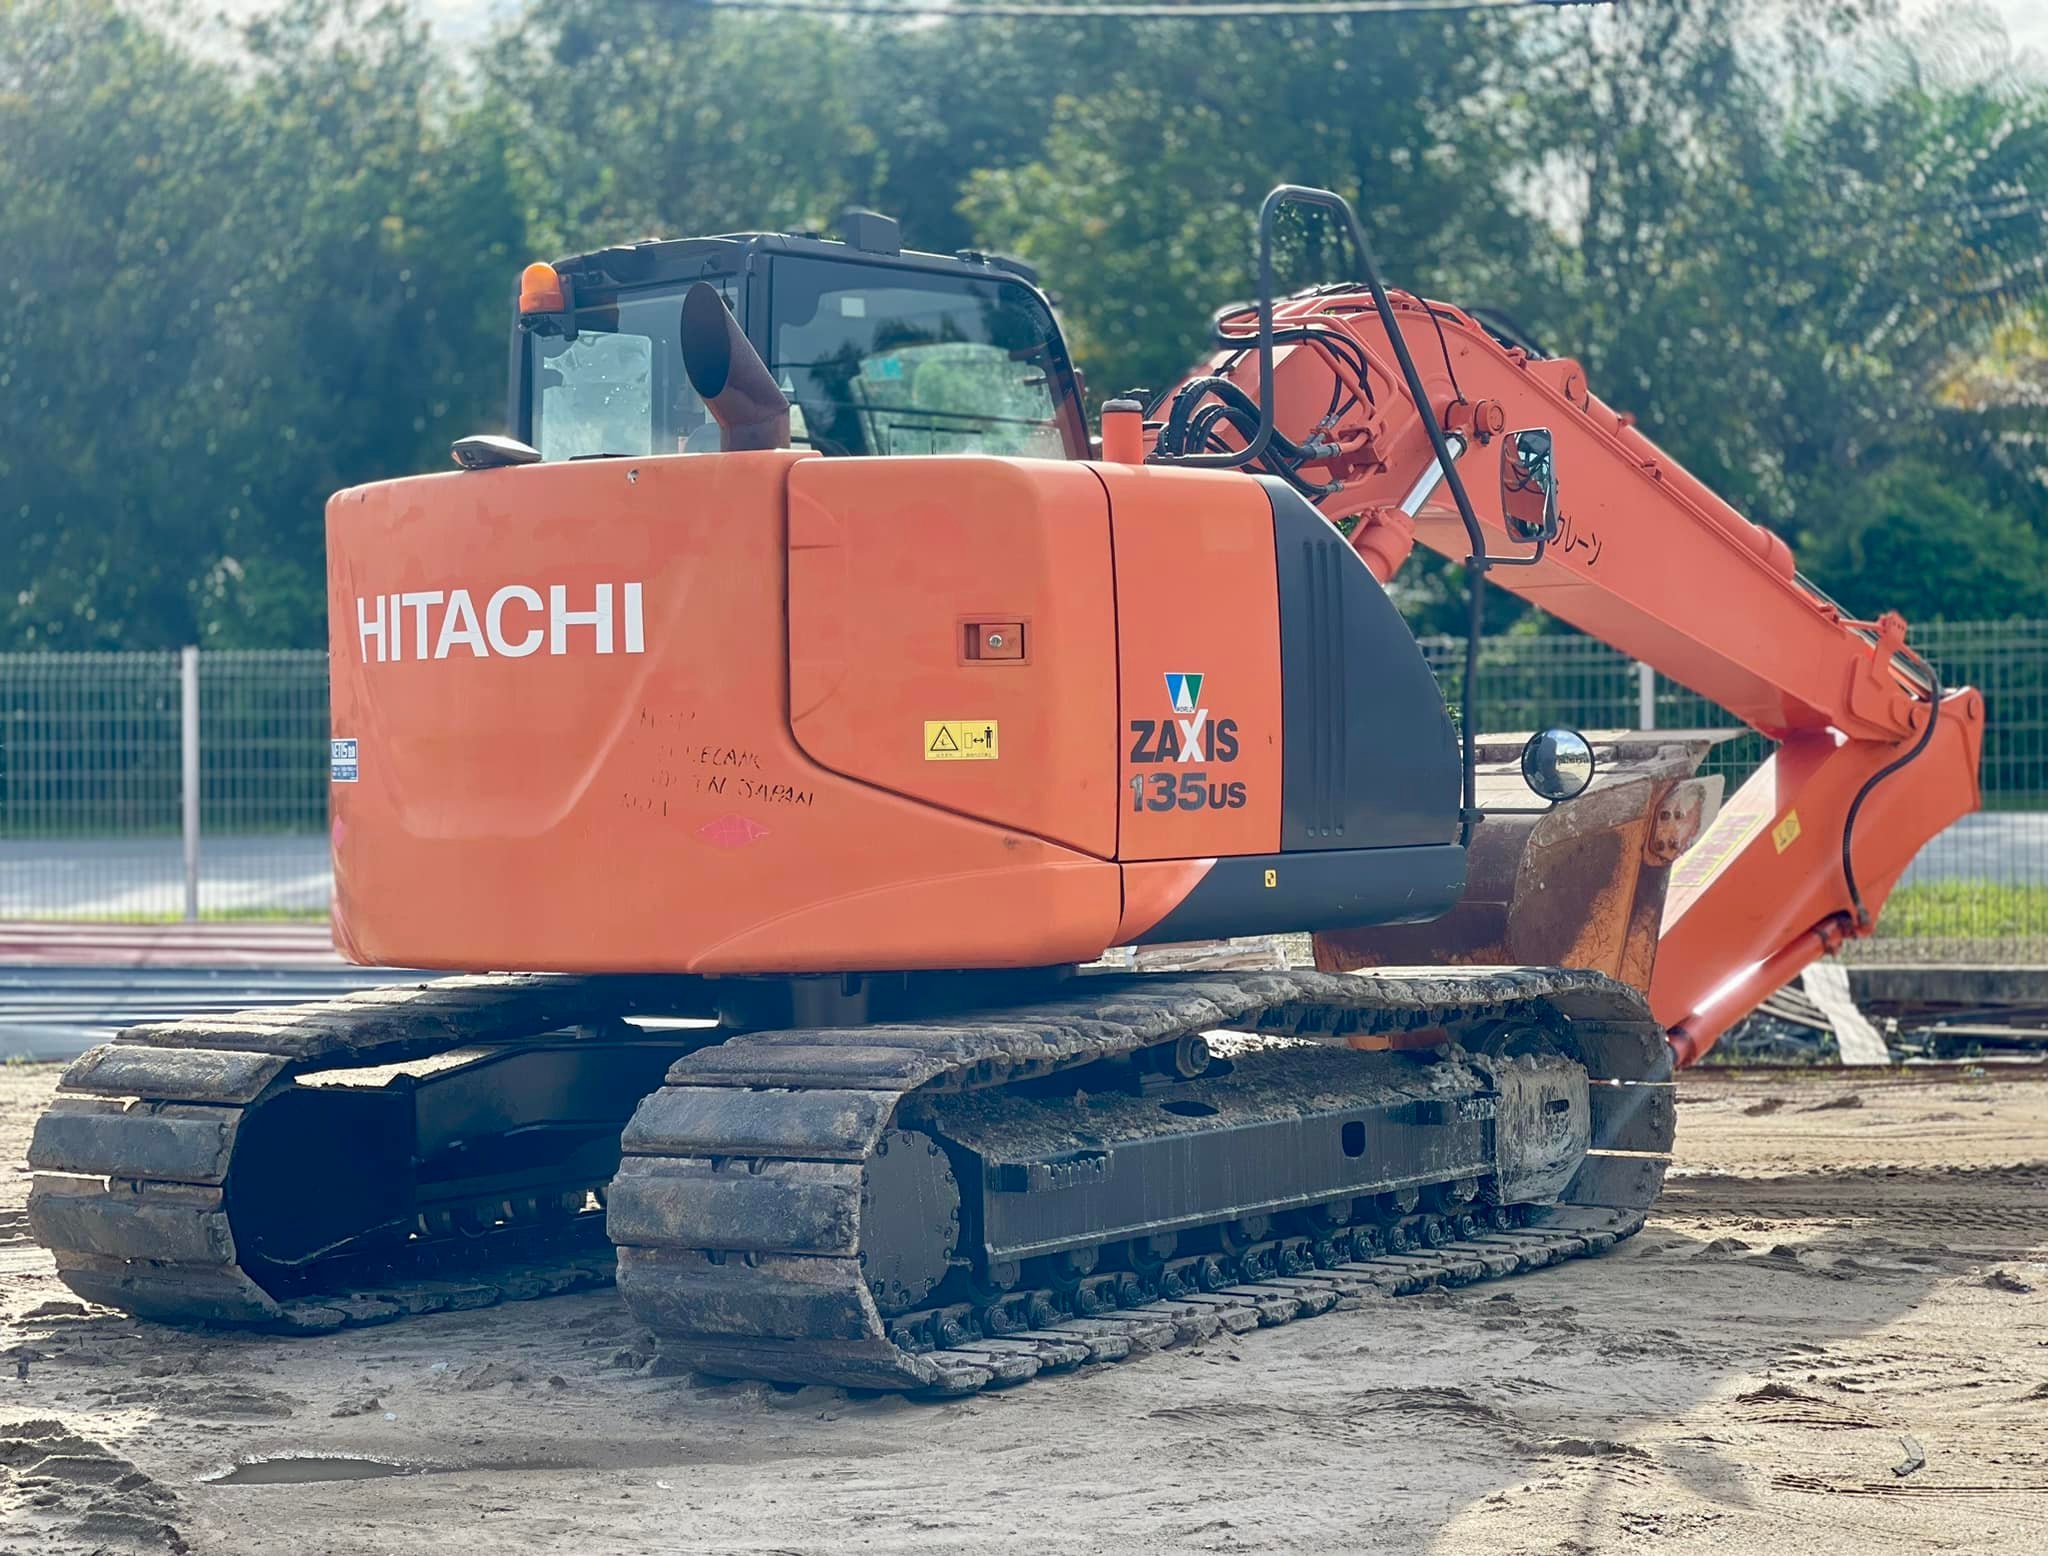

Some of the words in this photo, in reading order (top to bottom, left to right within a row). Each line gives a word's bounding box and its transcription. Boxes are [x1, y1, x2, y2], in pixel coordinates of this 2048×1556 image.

[356, 581, 646, 664] HITACHI
[1130, 709, 1239, 763] ZAXIS
[738, 777, 814, 807] JAPAN
[1130, 773, 1246, 812] 135US
